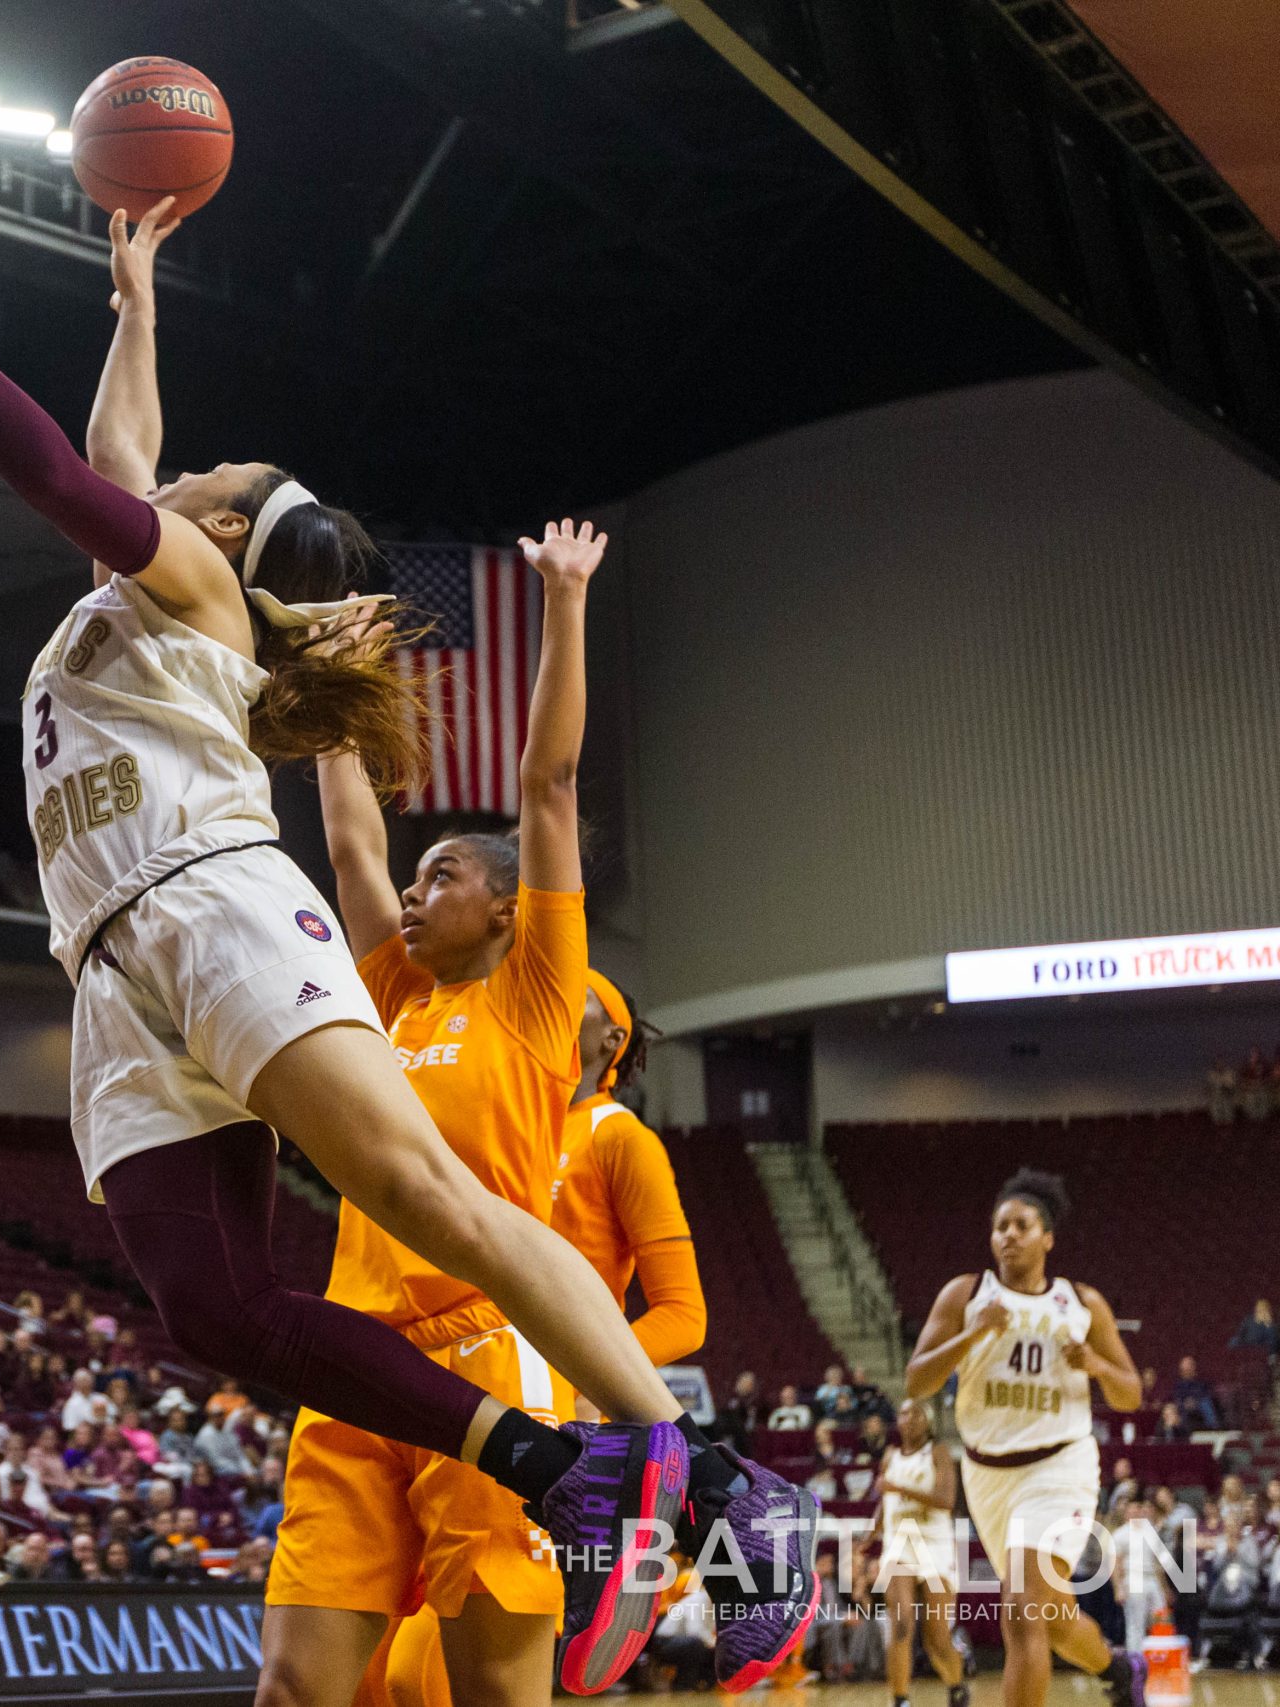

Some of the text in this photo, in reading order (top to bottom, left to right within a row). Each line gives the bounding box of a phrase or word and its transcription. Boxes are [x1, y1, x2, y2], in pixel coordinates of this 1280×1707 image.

[109, 86, 216, 120] Wilson
[34, 691, 59, 770] 3
[34, 752, 144, 866] GGIES
[1032, 957, 1118, 984] FORD
[1133, 945, 1235, 979] TRUCK
[295, 990, 332, 1007] adidas
[1009, 1340, 1042, 1374] 40
